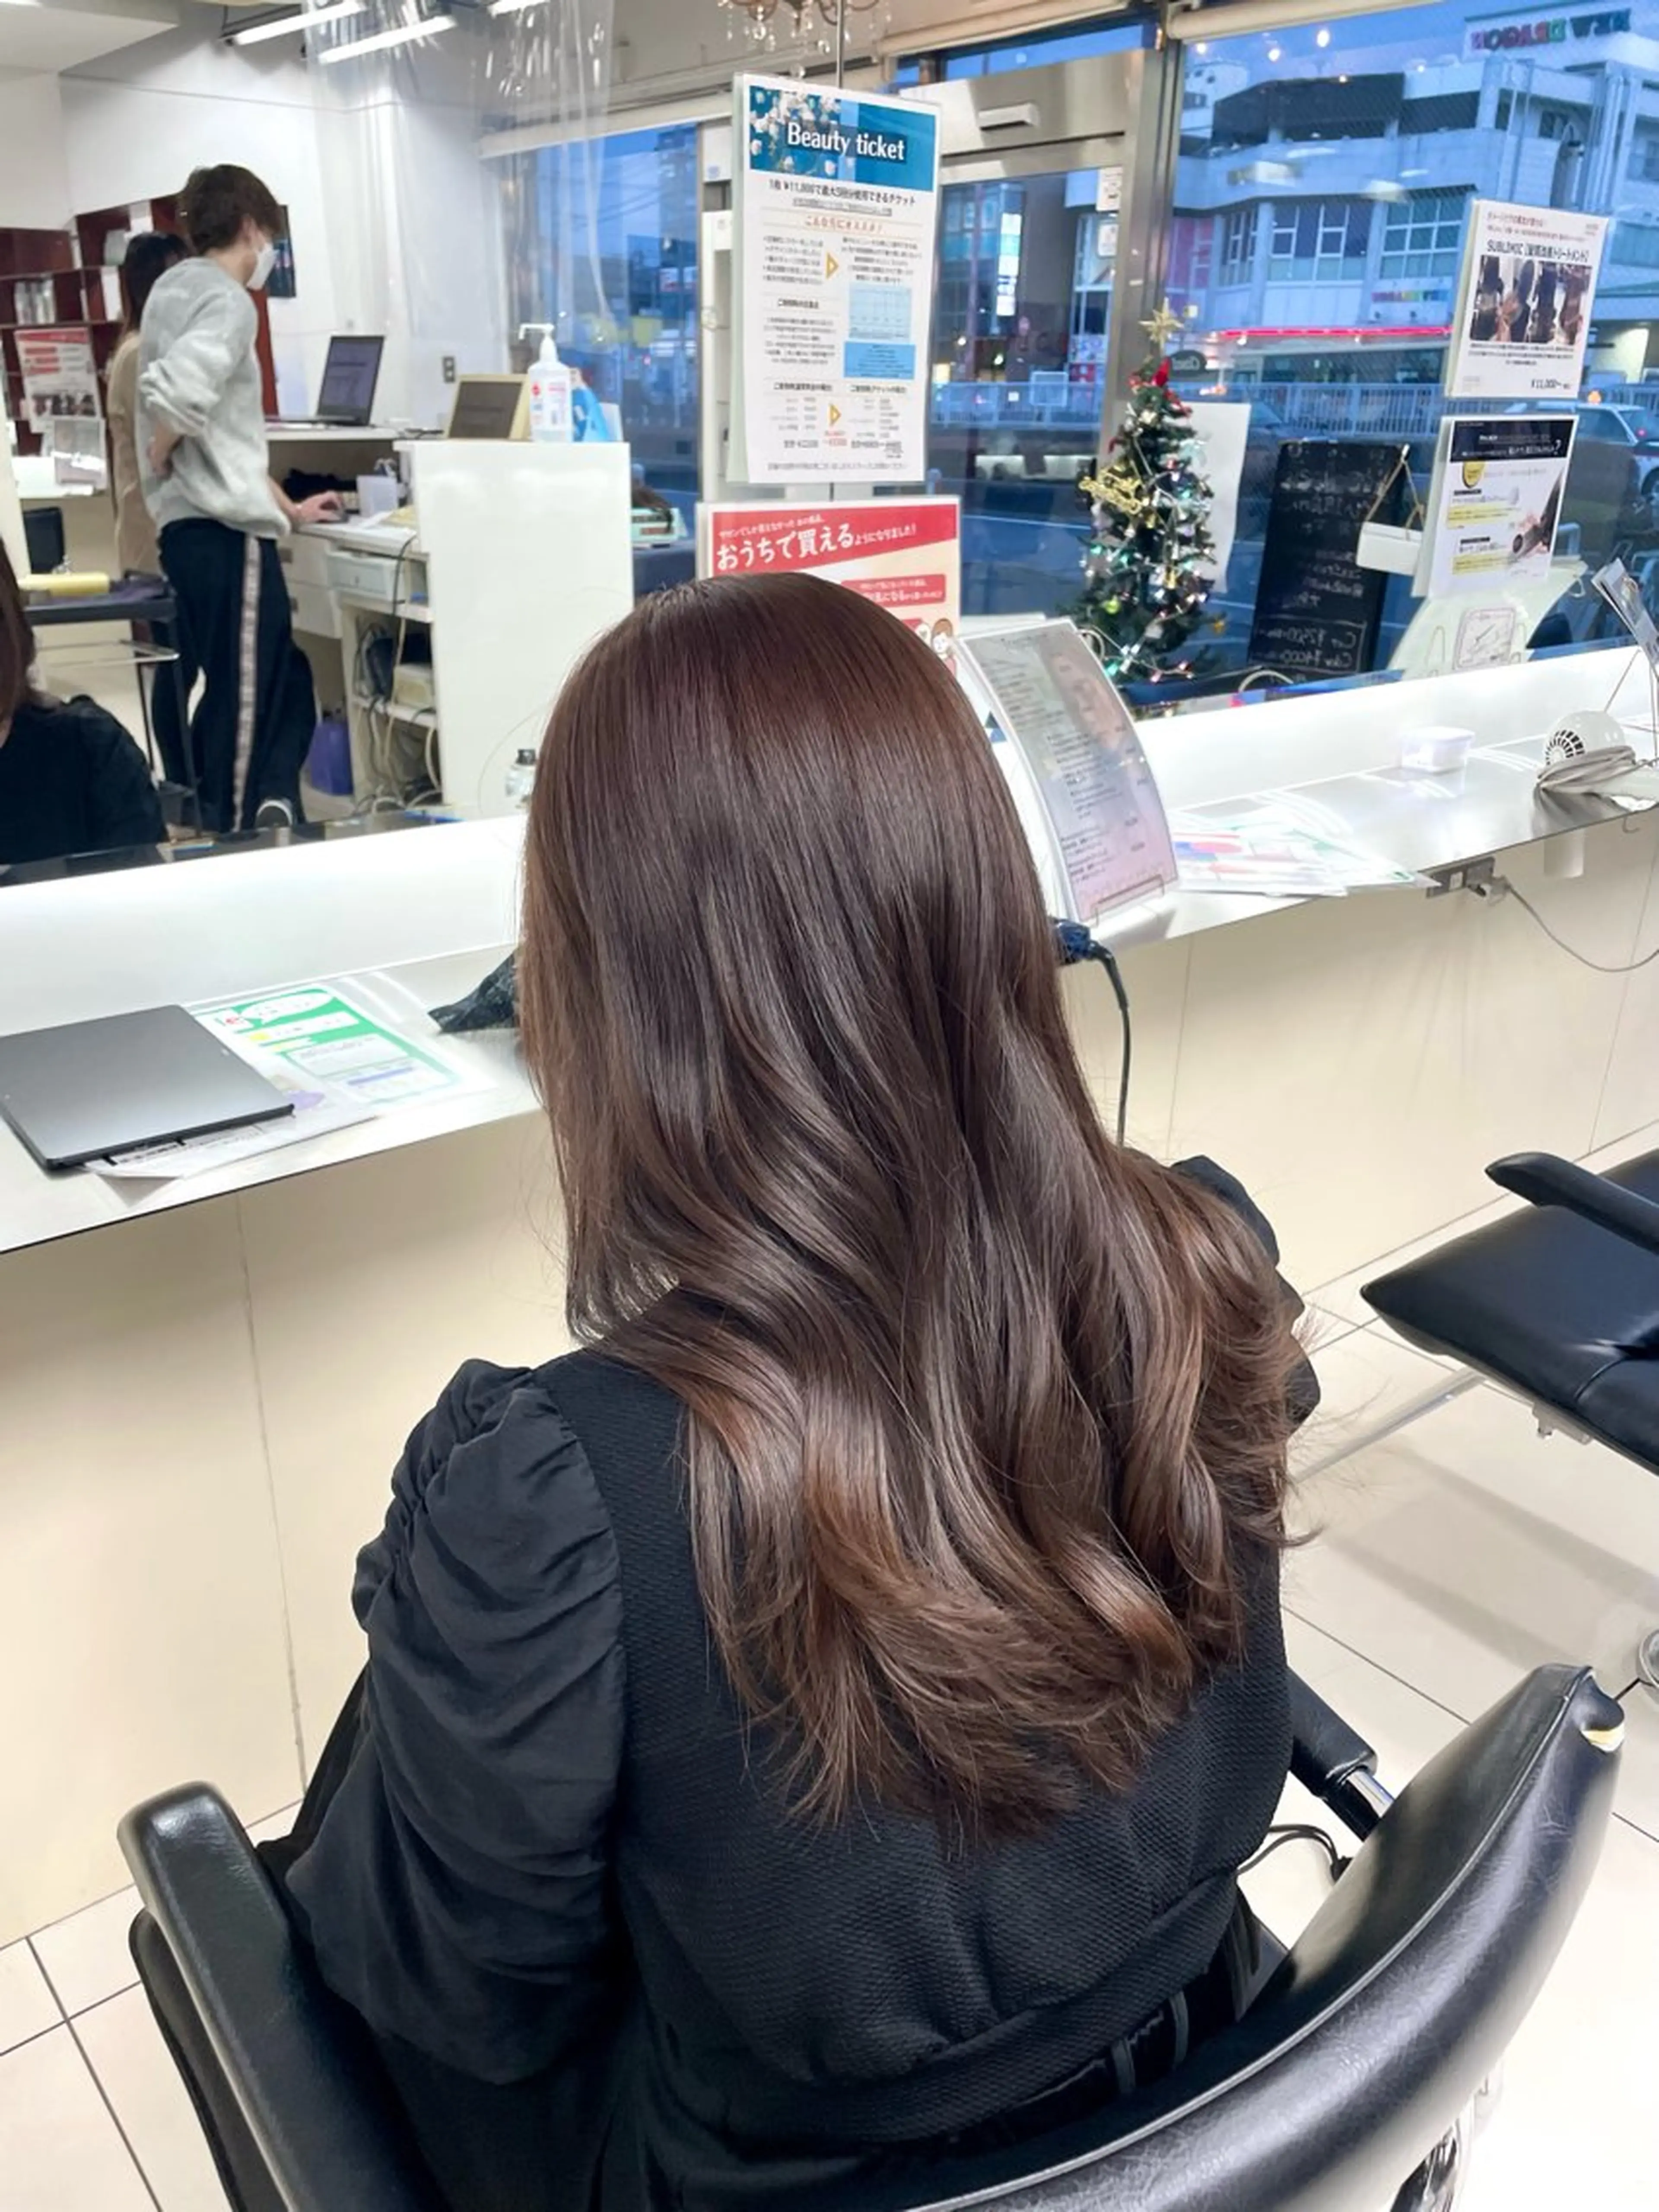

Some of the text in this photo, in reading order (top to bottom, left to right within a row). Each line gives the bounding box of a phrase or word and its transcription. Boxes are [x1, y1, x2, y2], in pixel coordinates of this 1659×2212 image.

[788, 122, 905, 160] Beauty ticket
[717, 523, 855, 572] おうちで買える
